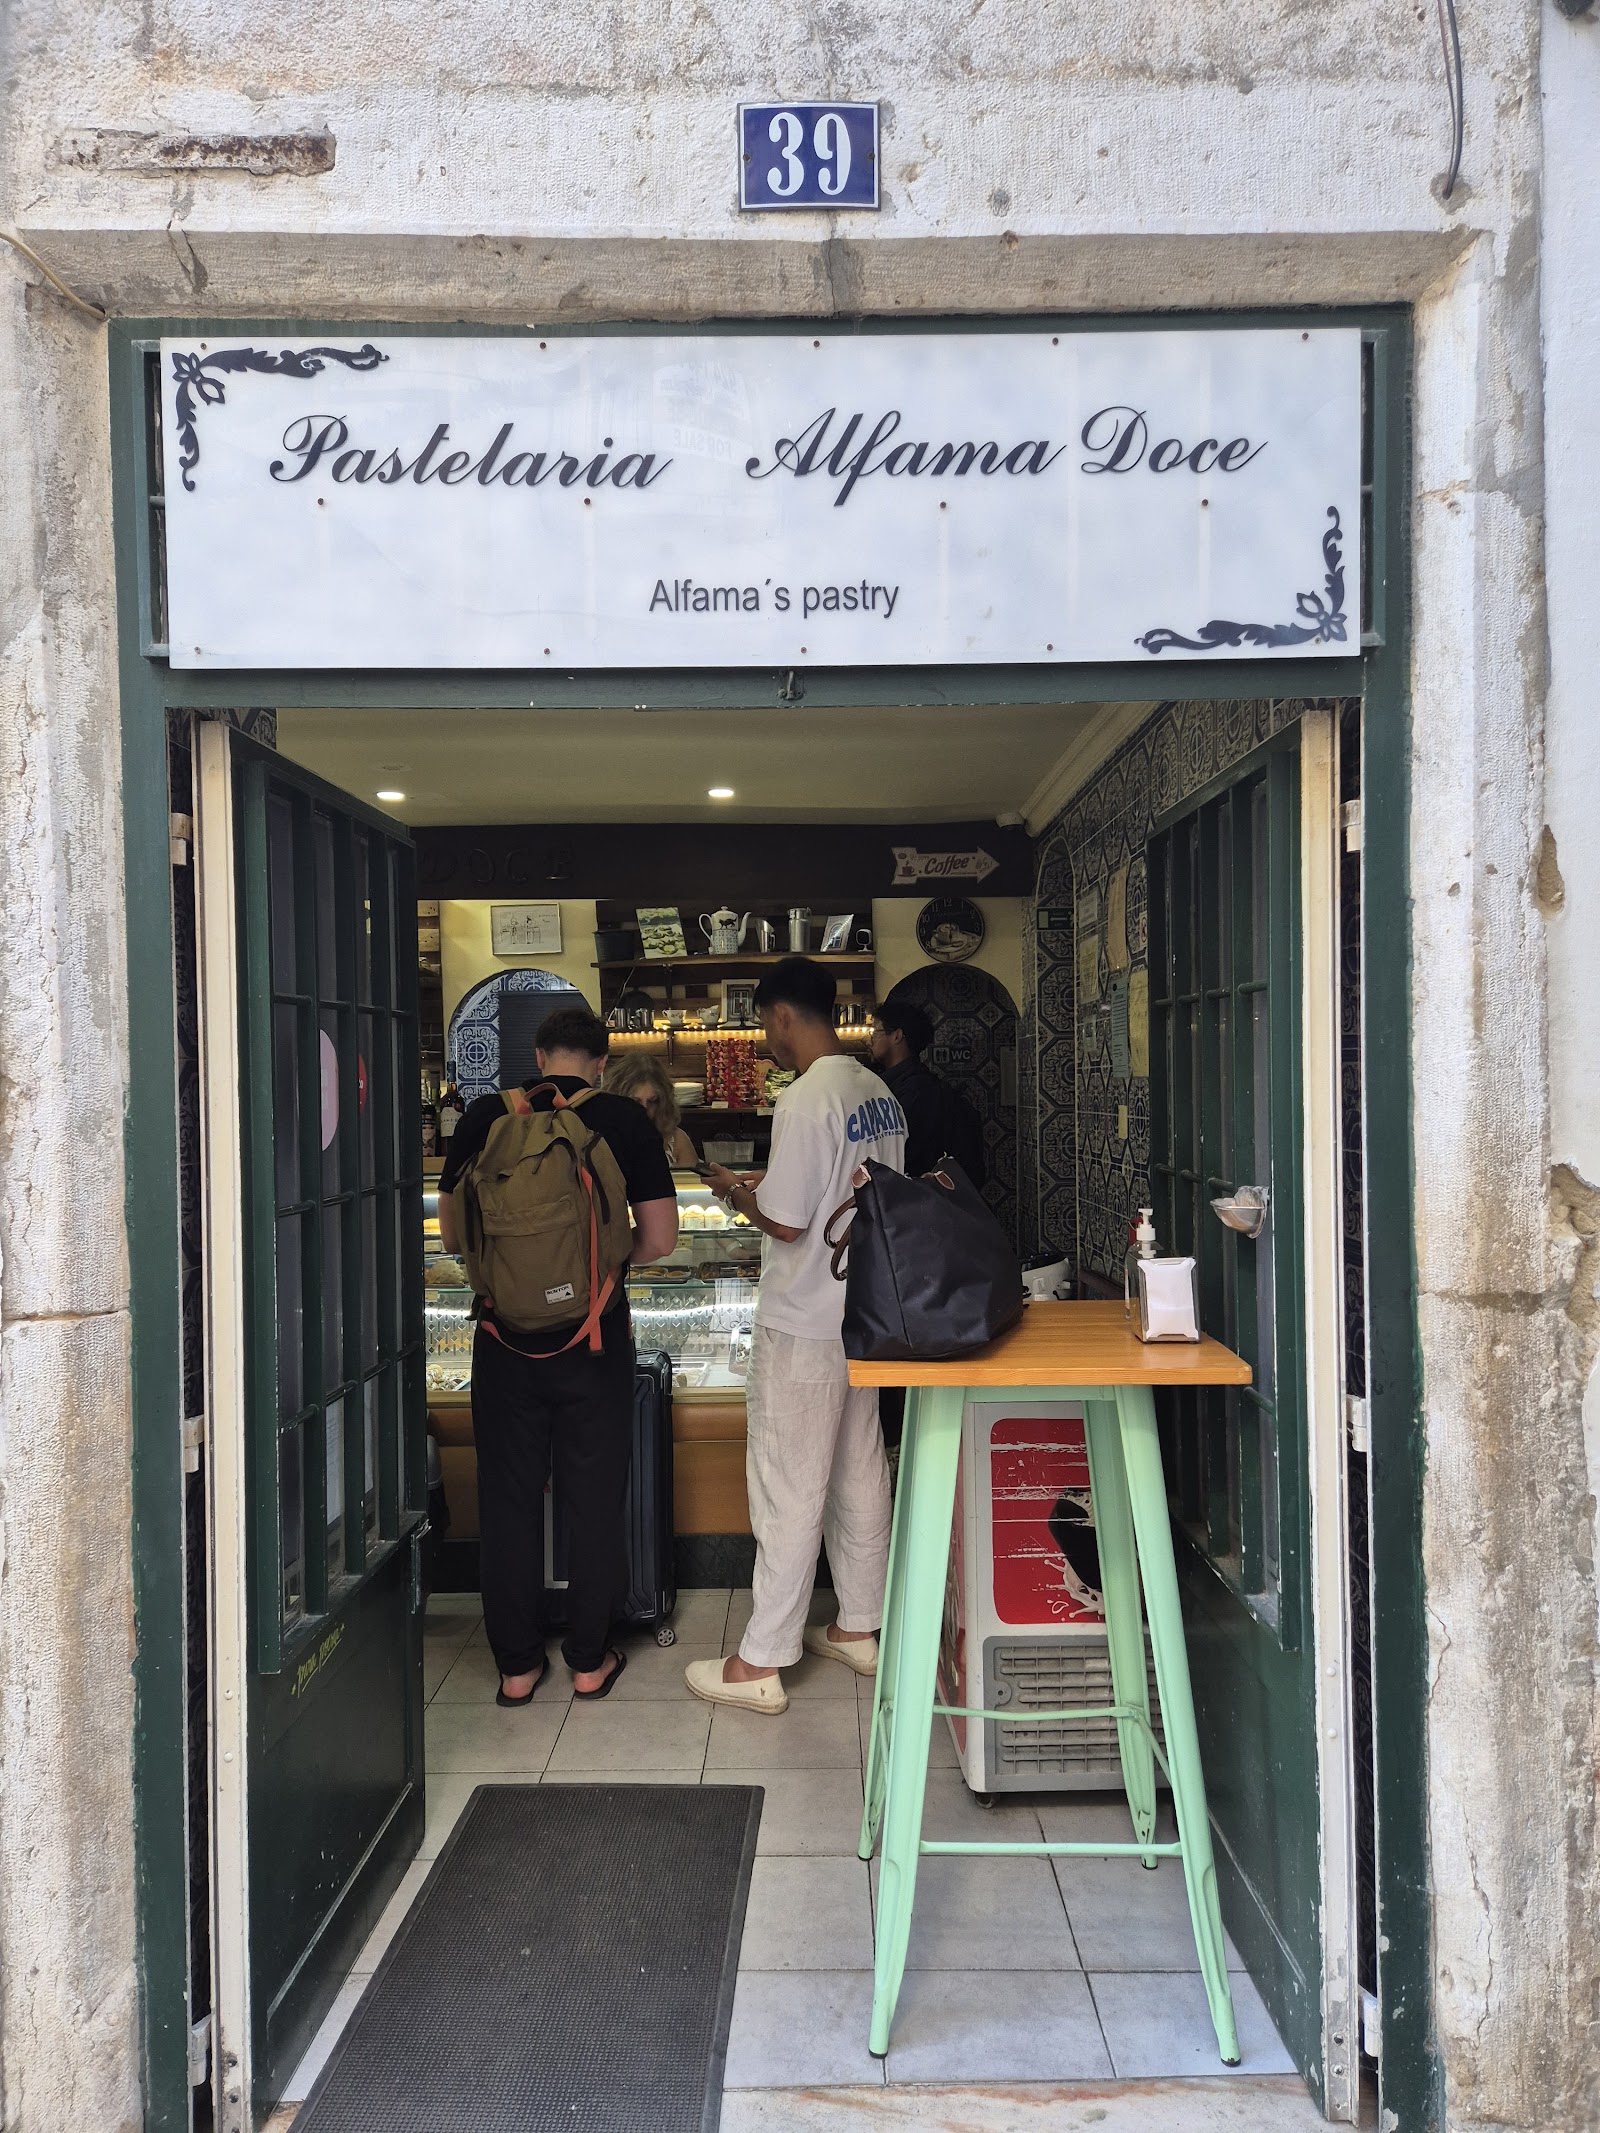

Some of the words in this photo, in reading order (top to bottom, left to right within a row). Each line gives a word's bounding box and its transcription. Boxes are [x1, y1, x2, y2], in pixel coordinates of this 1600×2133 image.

[767, 112, 851, 196] 39
[269, 414, 673, 488] Pastelaria
[745, 407, 1067, 507] Alfama
[1081, 406, 1268, 474] Doce
[803, 579, 899, 619] pastry
[924, 855, 970, 876] Coffee
[951, 1050, 971, 1060] WC
